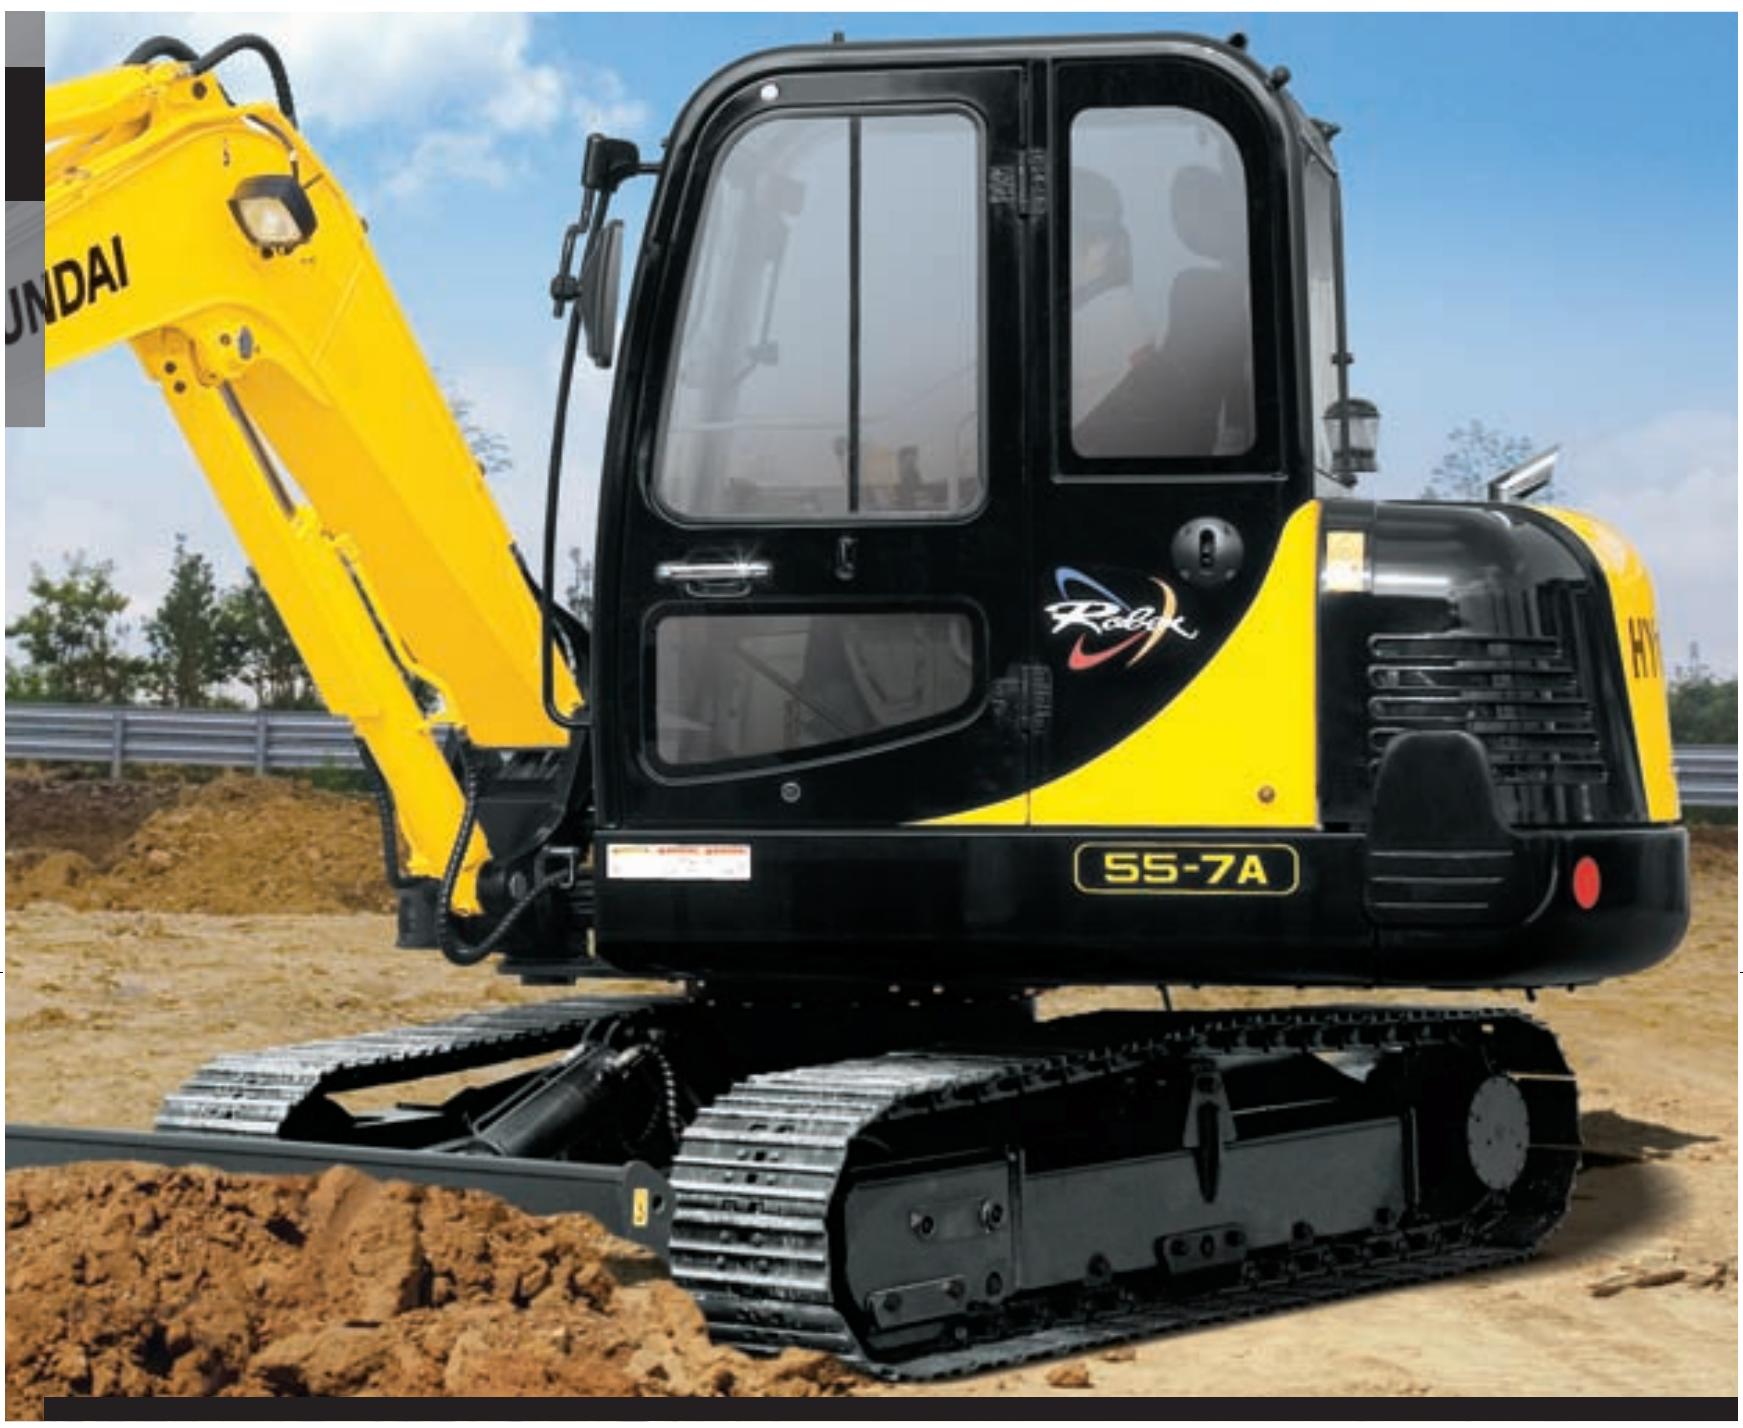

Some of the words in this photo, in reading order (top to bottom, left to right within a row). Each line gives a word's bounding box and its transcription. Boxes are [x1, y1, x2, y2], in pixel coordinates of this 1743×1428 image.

[1044, 600, 1199, 640] Robex
[1627, 615, 1660, 679] HY
[1104, 852, 1269, 885] 55-7A
